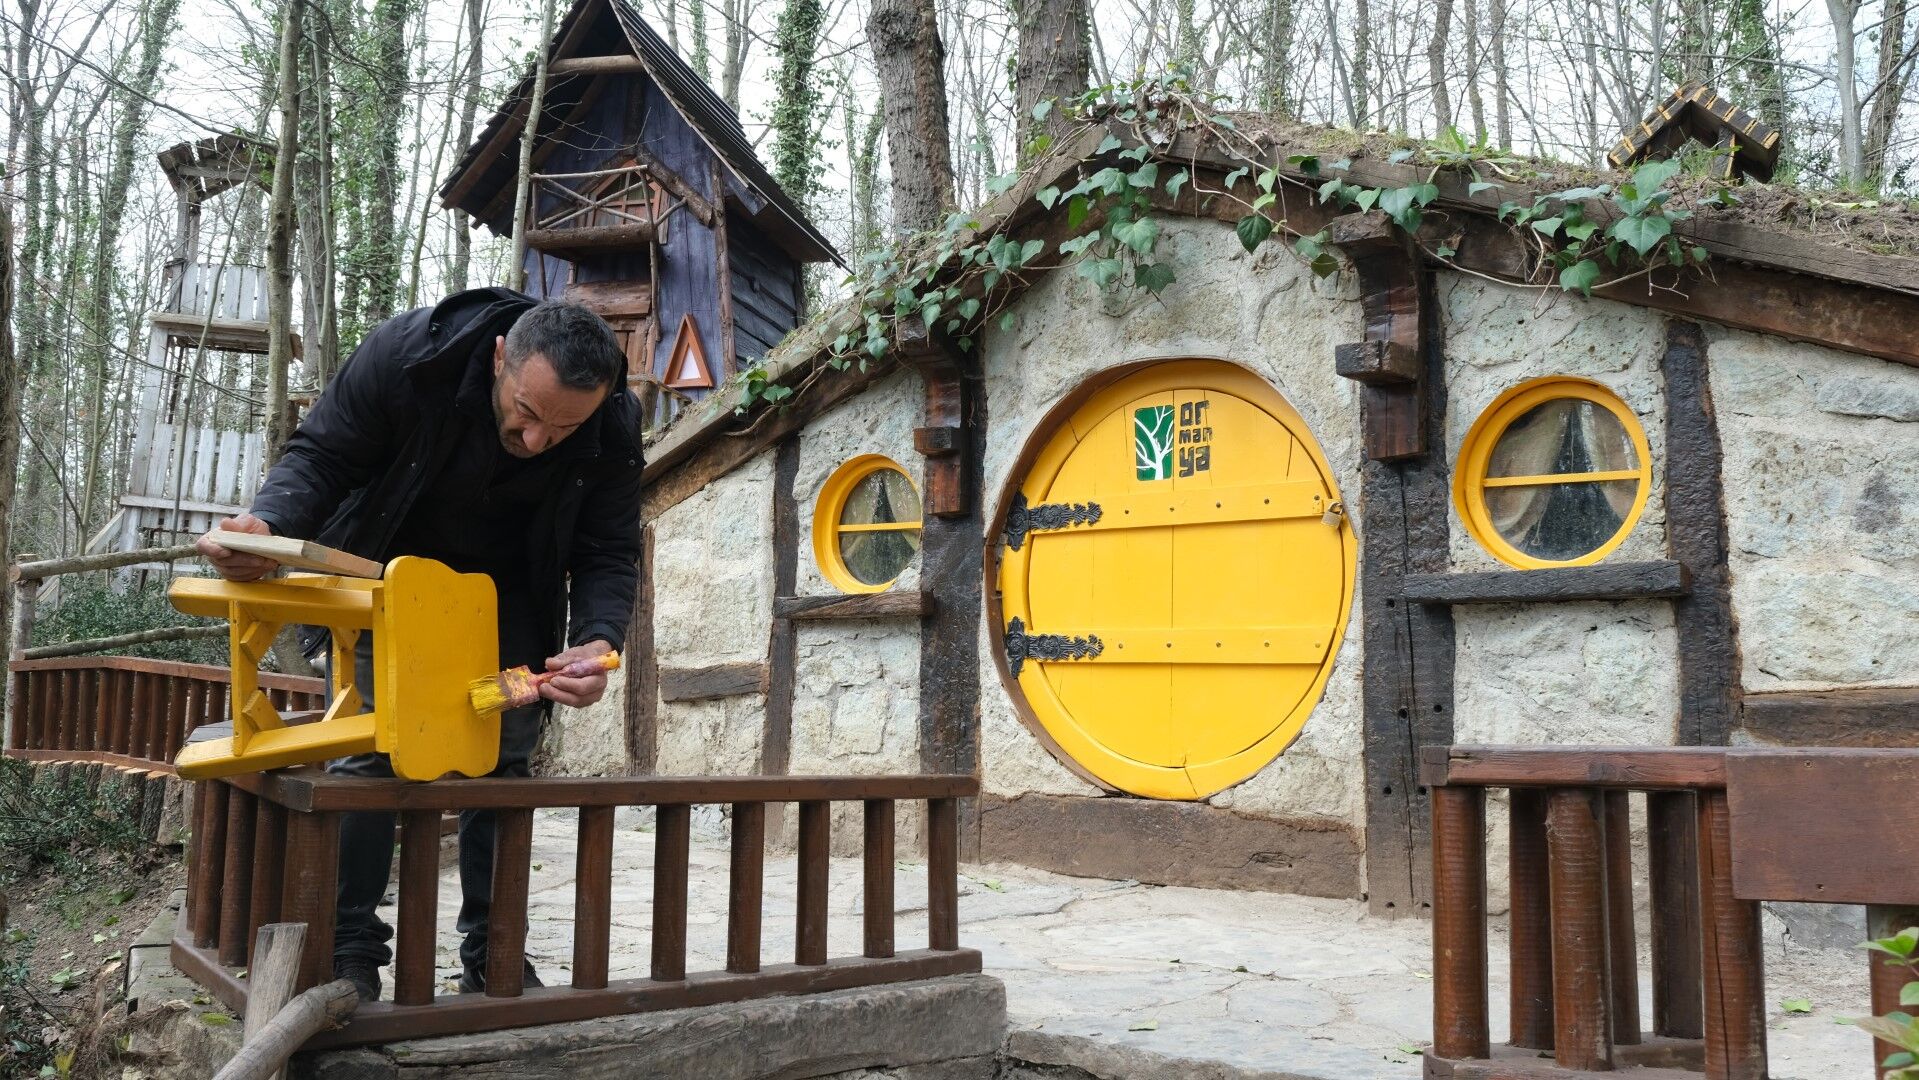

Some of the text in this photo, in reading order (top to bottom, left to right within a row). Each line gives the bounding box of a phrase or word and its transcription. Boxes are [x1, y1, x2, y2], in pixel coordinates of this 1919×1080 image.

[1180, 400, 1210, 426] or
[1179, 427, 1213, 444] man
[1179, 446, 1210, 478] ya
